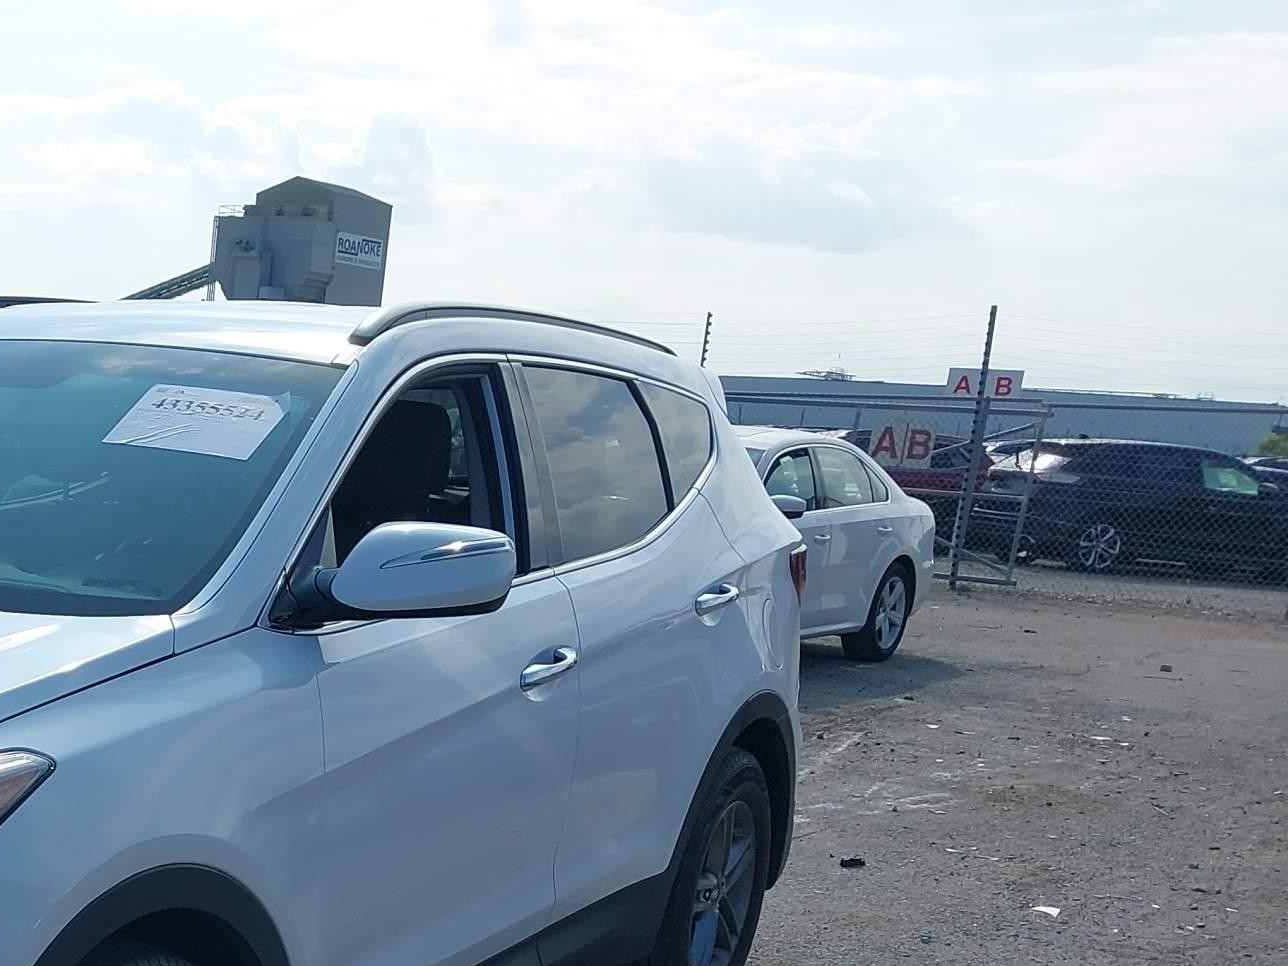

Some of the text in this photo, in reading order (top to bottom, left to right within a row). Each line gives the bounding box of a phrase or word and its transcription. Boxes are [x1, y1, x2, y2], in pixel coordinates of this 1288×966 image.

[338, 237, 382, 257] ROANOKE
[953, 375, 1013, 396] A B
[152, 397, 265, 421] 43355524
[871, 426, 932, 460] A B
